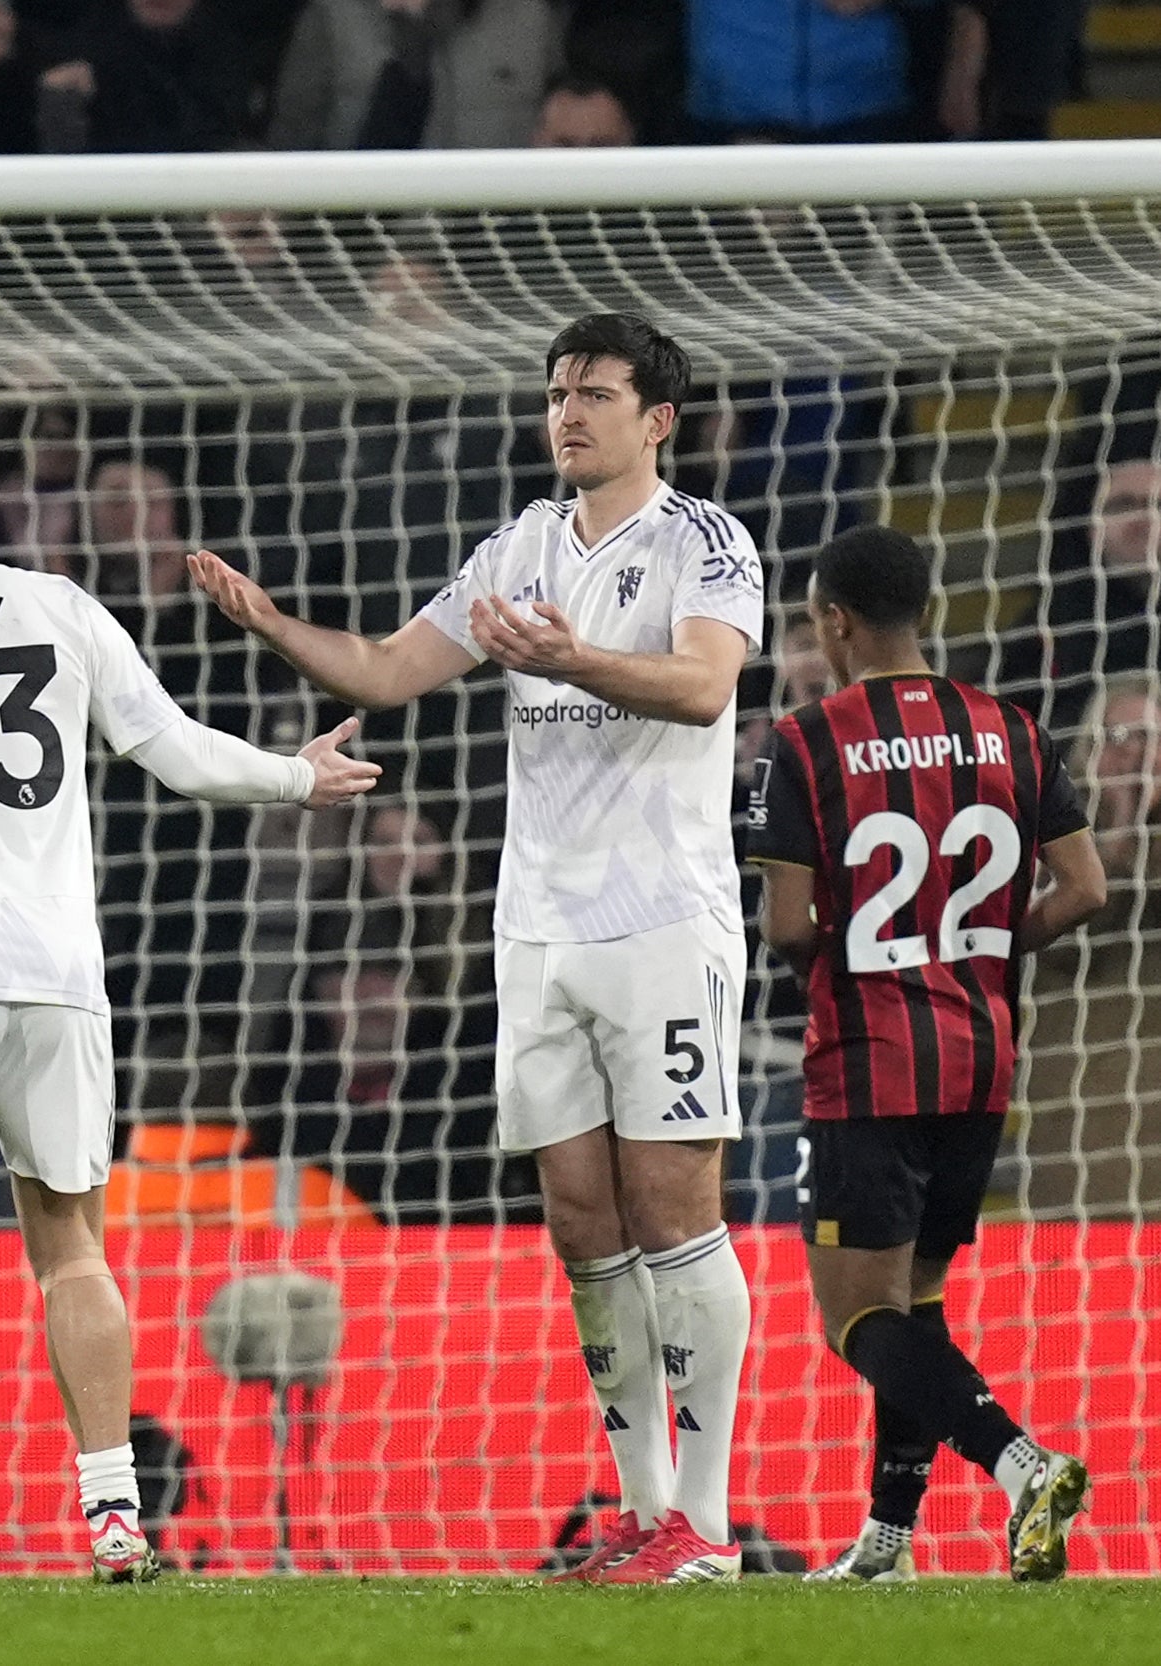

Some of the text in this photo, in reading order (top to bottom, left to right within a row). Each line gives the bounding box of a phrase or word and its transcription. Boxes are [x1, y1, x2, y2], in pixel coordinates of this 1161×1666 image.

[844, 732, 1006, 775] KROUPI.JR
[843, 804, 1022, 973] 22
[664, 1018, 705, 1084] 5
